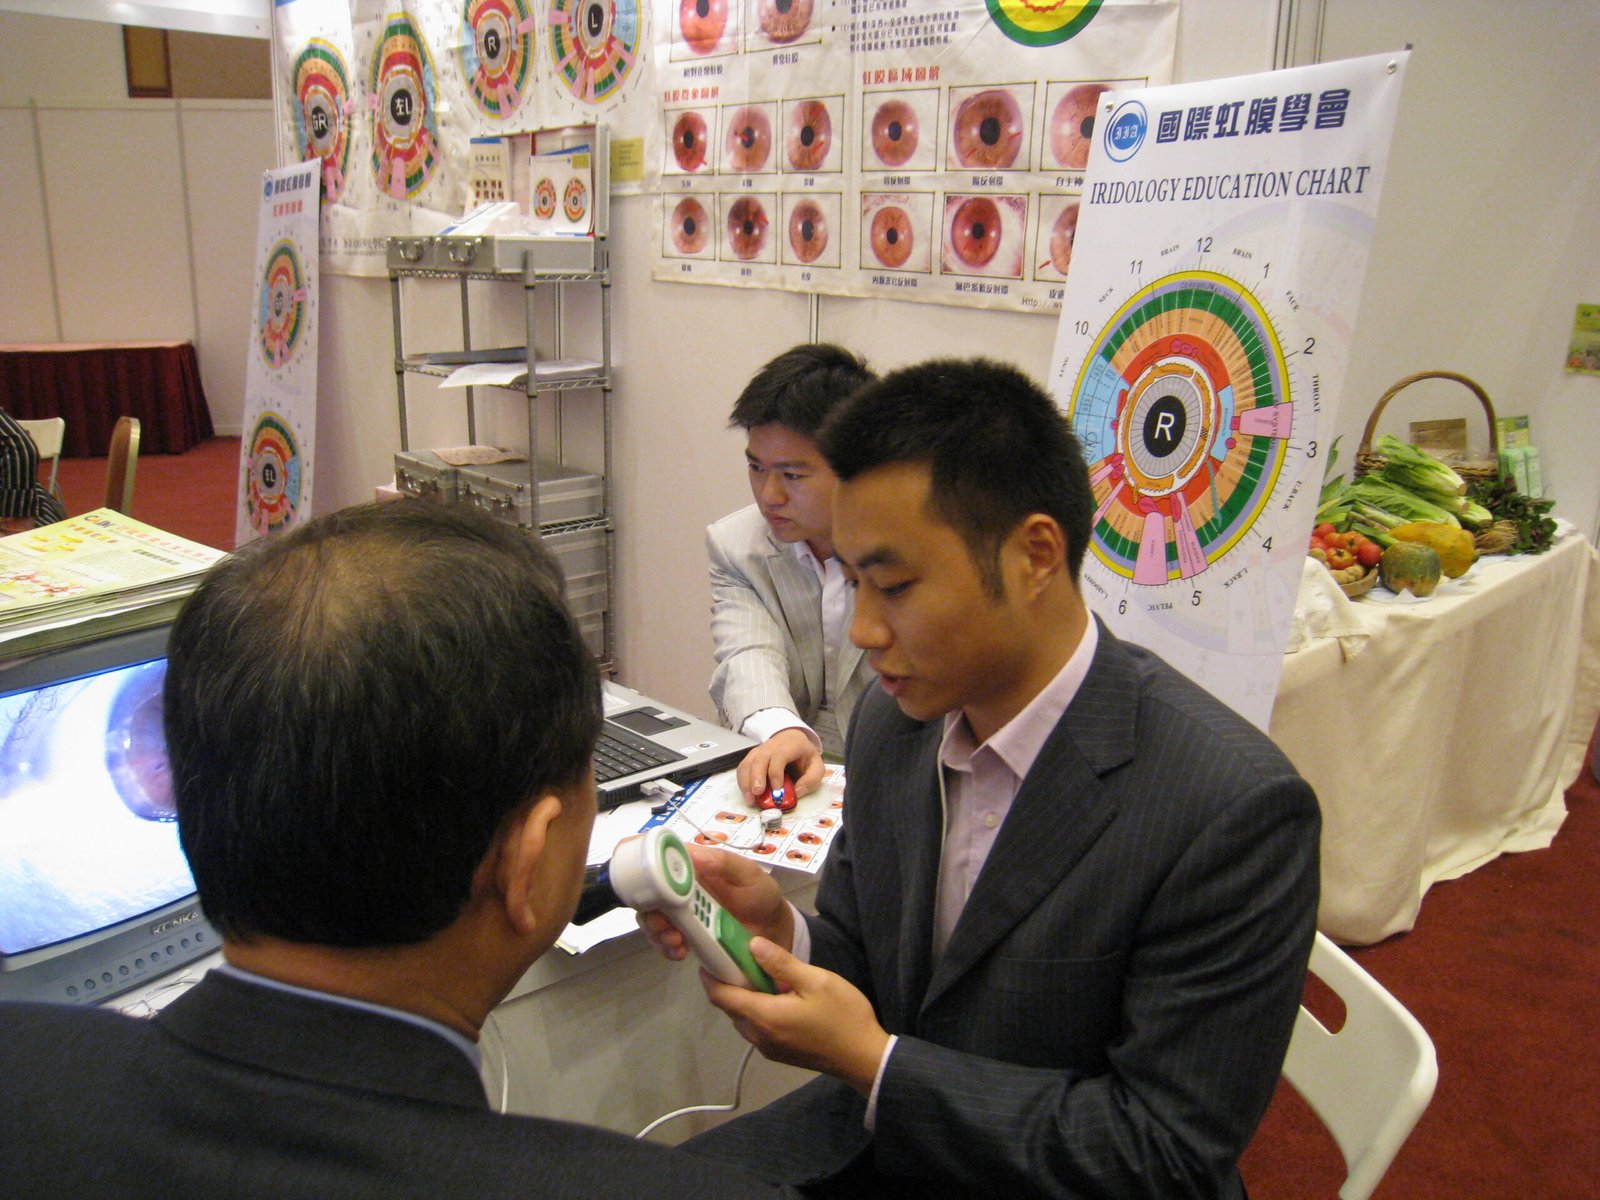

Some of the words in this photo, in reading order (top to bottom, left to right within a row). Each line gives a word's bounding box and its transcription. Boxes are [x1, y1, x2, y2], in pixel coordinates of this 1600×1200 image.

[590, 12, 599, 28] L
[487, 36, 497, 51] R
[1155, 88, 1351, 144] 國際虹膜學會
[1089, 176, 1181, 205] IRIDOLOGY
[1182, 170, 1294, 201] EDUCATION
[1295, 165, 1371, 196] CHART
[1160, 244, 1180, 257] BRAIN
[1196, 236, 1213, 253] 12
[1232, 247, 1253, 260] BRAIN
[1129, 260, 1143, 275] 11
[1263, 263, 1270, 279] 1
[1285, 290, 1300, 313] FACE
[1074, 321, 1089, 335] 10
[1303, 337, 1316, 355] 2
[1312, 373, 1320, 413] THROAT
[1153, 411, 1176, 442] R
[1306, 441, 1317, 458] 3
[1262, 536, 1273, 552] 4
[1191, 590, 1202, 606] 5
[1118, 600, 1128, 615] 6
[1147, 602, 1173, 611] PELVIC
